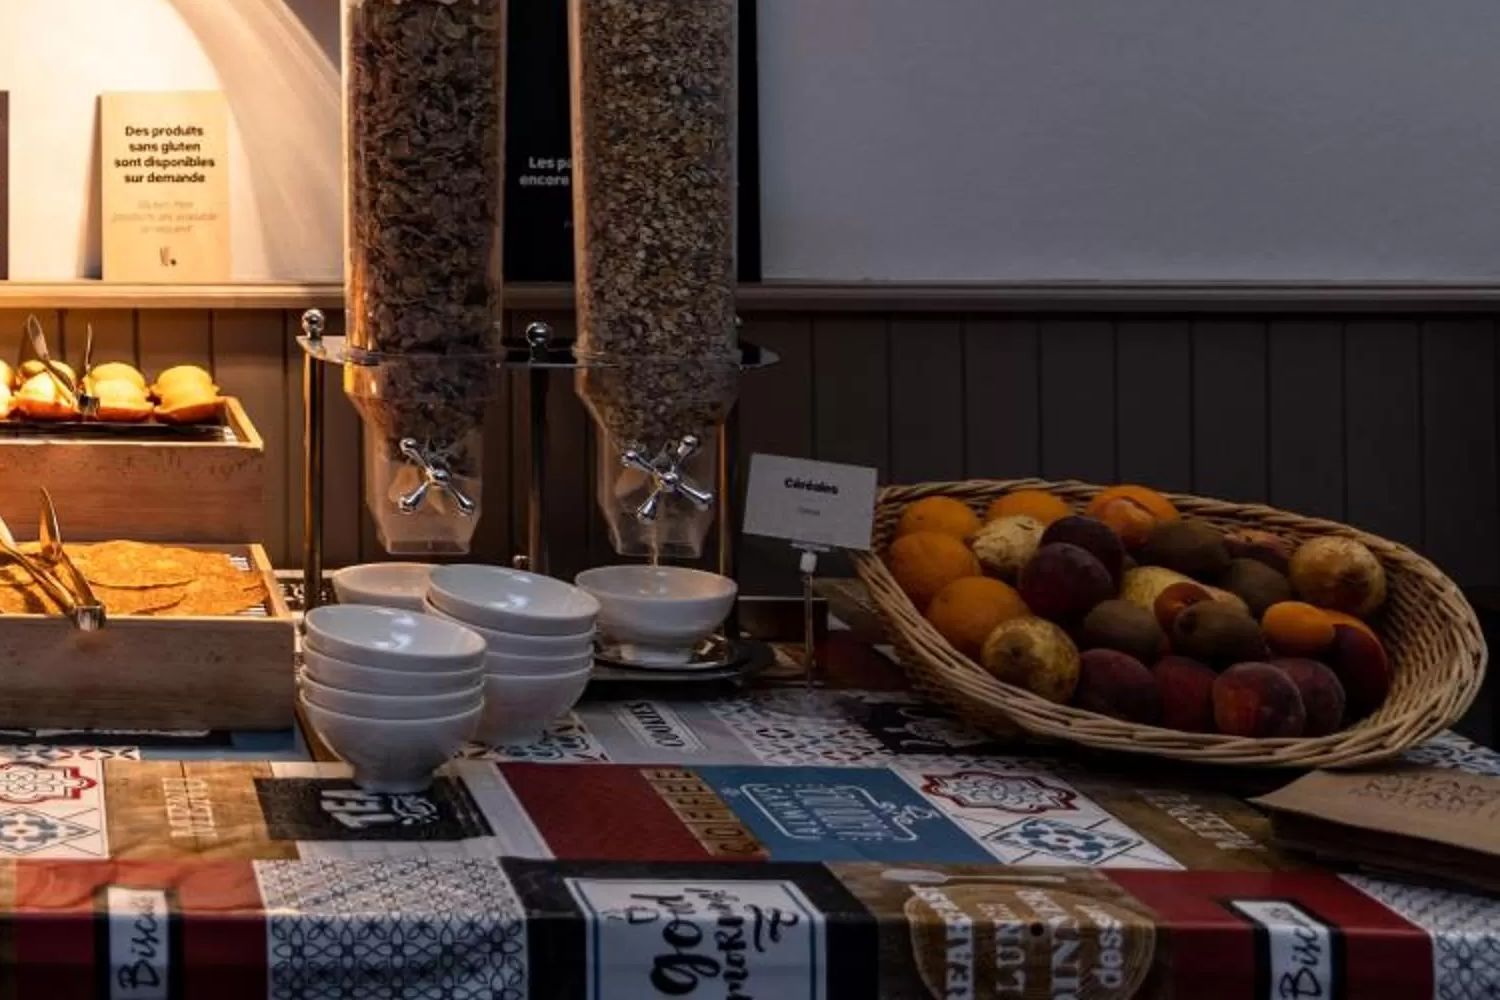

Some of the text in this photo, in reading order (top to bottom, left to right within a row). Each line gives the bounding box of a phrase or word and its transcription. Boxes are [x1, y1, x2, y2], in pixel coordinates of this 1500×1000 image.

[124, 124, 204, 138] Des produits
[128, 140, 201, 155] sans gluten
[114, 156, 216, 170] sont disponibles
[528, 155, 555, 169] Les
[124, 171, 206, 184] sur demande
[654, 772, 761, 855] COFFEE
